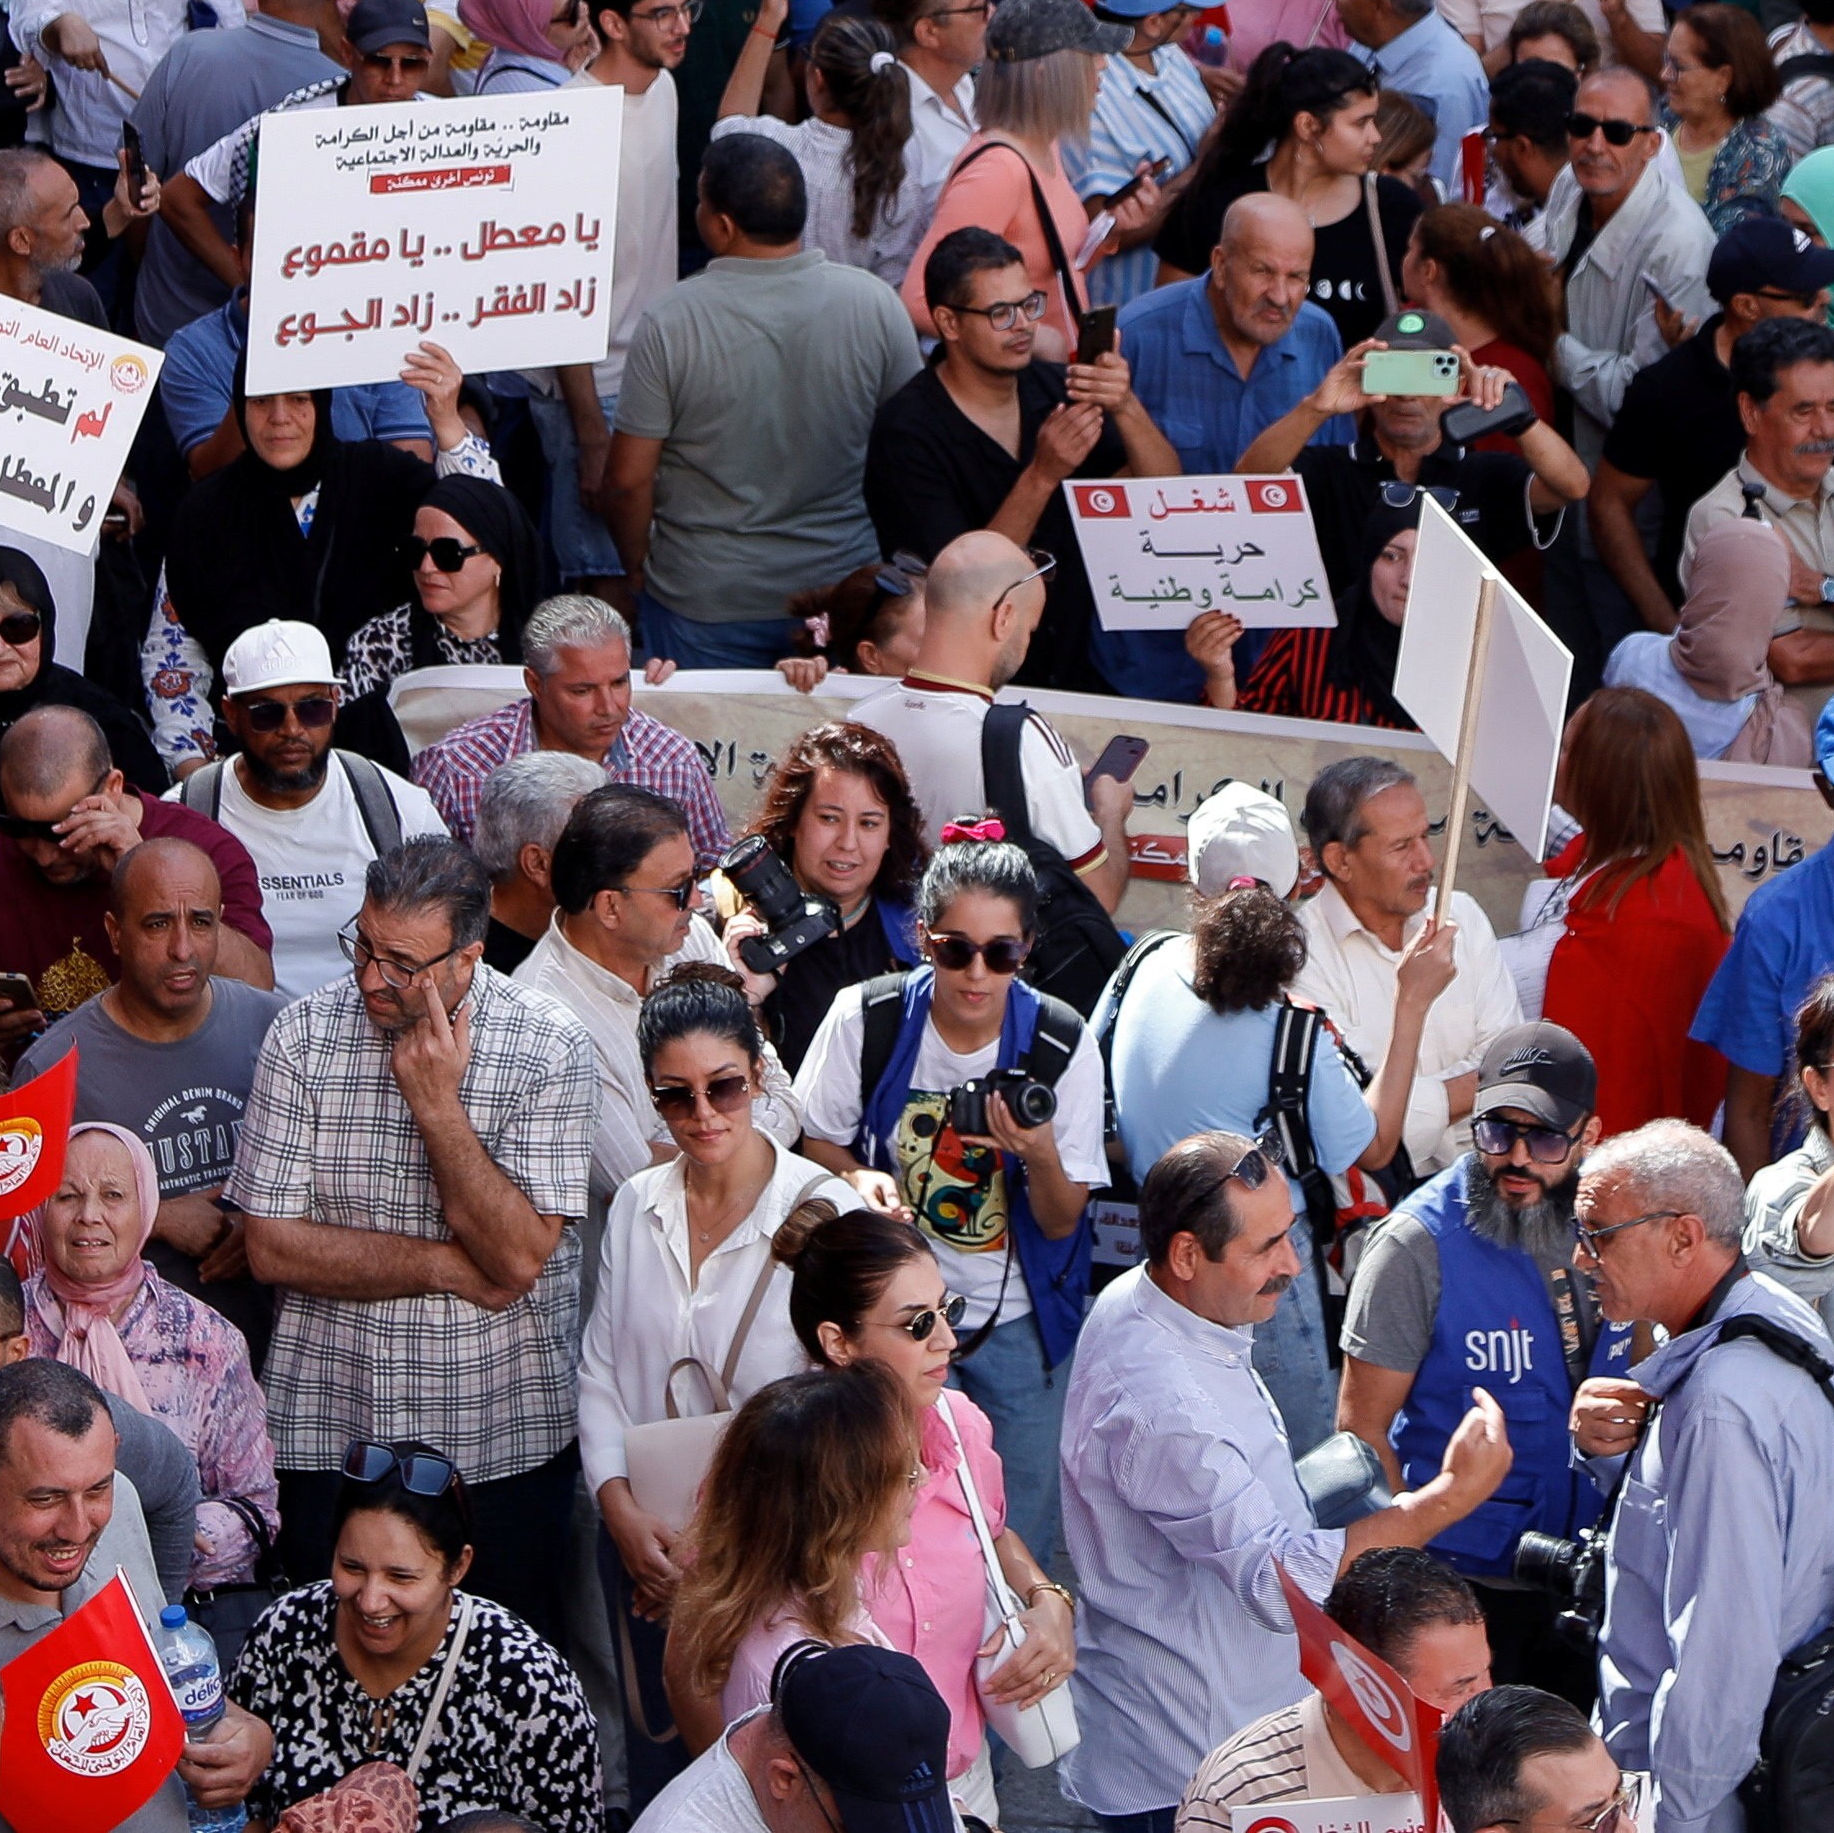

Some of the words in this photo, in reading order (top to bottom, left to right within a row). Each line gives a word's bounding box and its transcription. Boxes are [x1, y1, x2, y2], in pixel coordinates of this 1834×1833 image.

[315, 125, 388, 150] الكرامة
[390, 119, 414, 143] أجل
[418, 126, 441, 141] من
[445, 117, 496, 138] مقاومة
[519, 111, 570, 132] مقاومة
[335, 146, 416, 171] الاجتماعية
[421, 141, 479, 163] والعدالة
[399, 228, 425, 268] يا
[460, 220, 566, 262] معطل
[575, 212, 600, 252] يا
[280, 231, 390, 280] مقموع
[390, 291, 434, 334] زاد
[467, 282, 547, 329] الفقر
[554, 276, 596, 318] زاد
[275, 297, 383, 347] الجوع
[20, 329, 60, 354] العام
[70, 401, 113, 444] لم
[1149, 488, 1236, 520] شغل
[1139, 530, 1265, 565] حرية
[1108, 574, 1213, 610] وطنية
[1219, 573, 1320, 608] كرامة
[261, 872, 344, 891] SSENTIALS
[144, 1095, 181, 1133] ORIGINAL
[182, 1087, 213, 1101] DENIM
[215, 1088, 244, 1110] BRAND
[159, 1174, 202, 1191] AUTHENTIC
[1465, 1318, 1534, 1384] snjt
